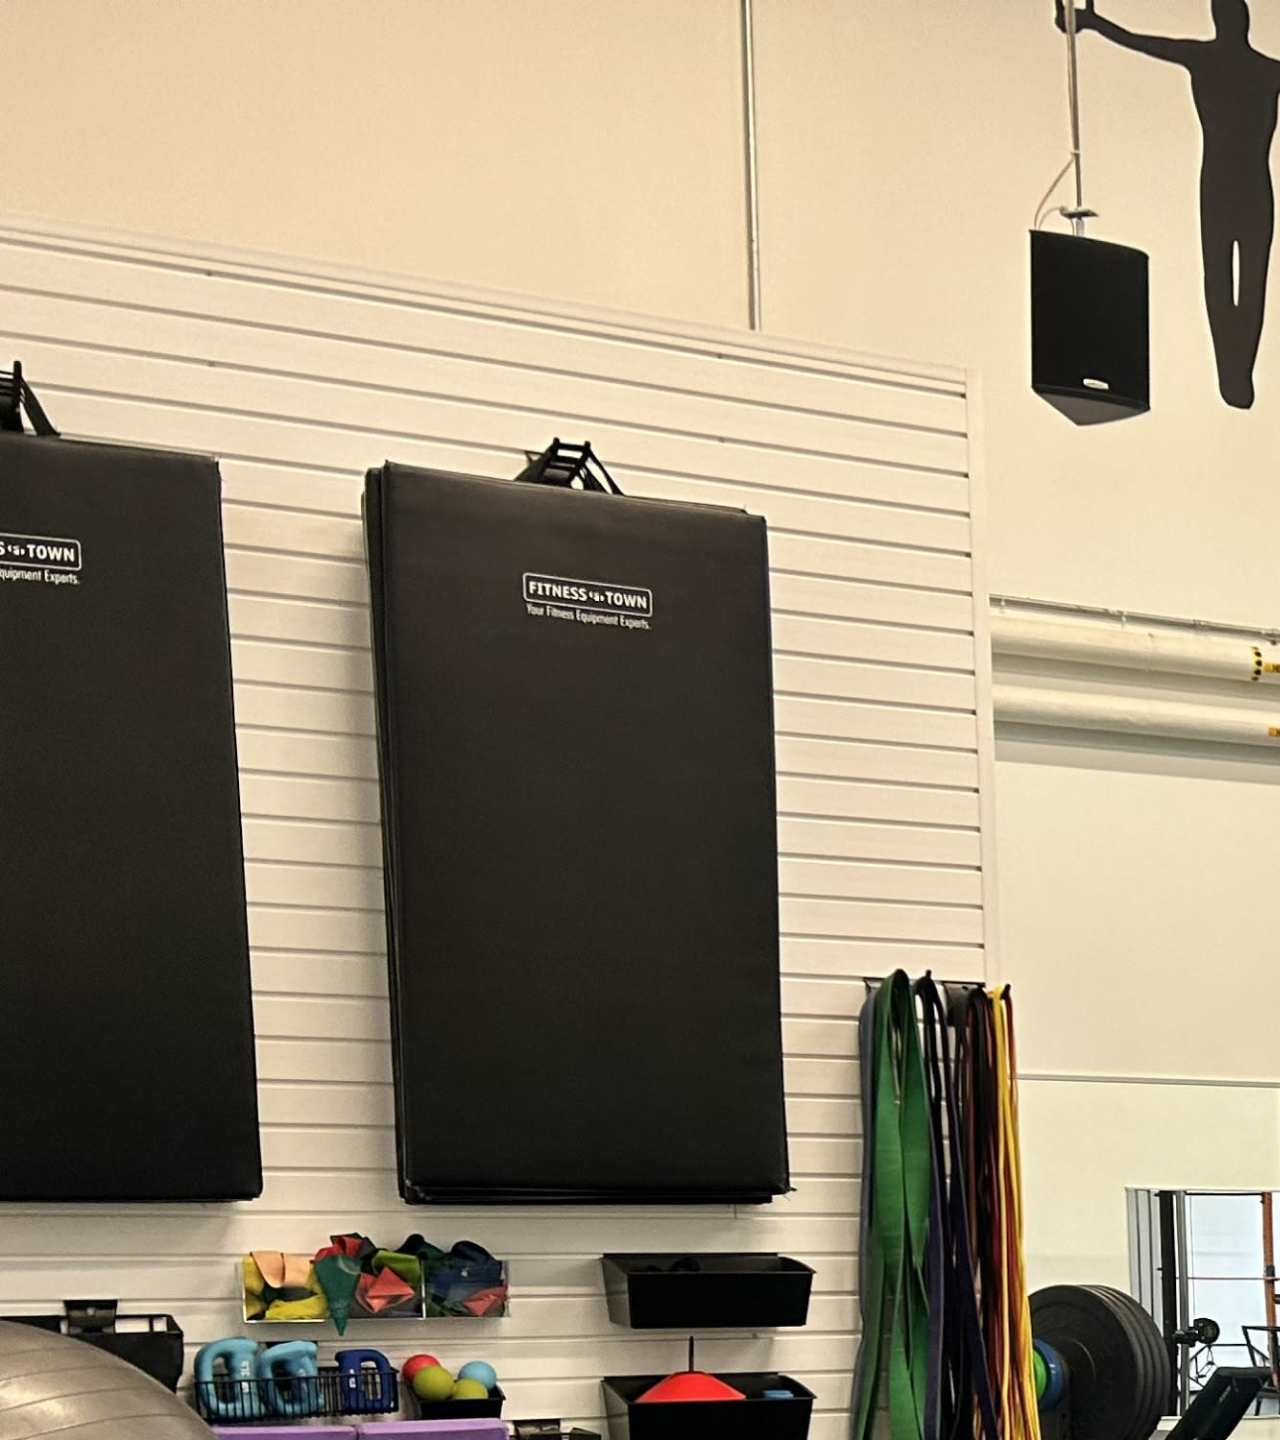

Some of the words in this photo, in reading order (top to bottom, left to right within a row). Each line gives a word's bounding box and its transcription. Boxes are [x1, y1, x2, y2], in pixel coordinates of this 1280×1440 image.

[27, 544, 75, 562] TOWN
[0, 566, 42, 581] quipment
[528, 580, 588, 602] FITNESS
[604, 591, 648, 609] TOWN
